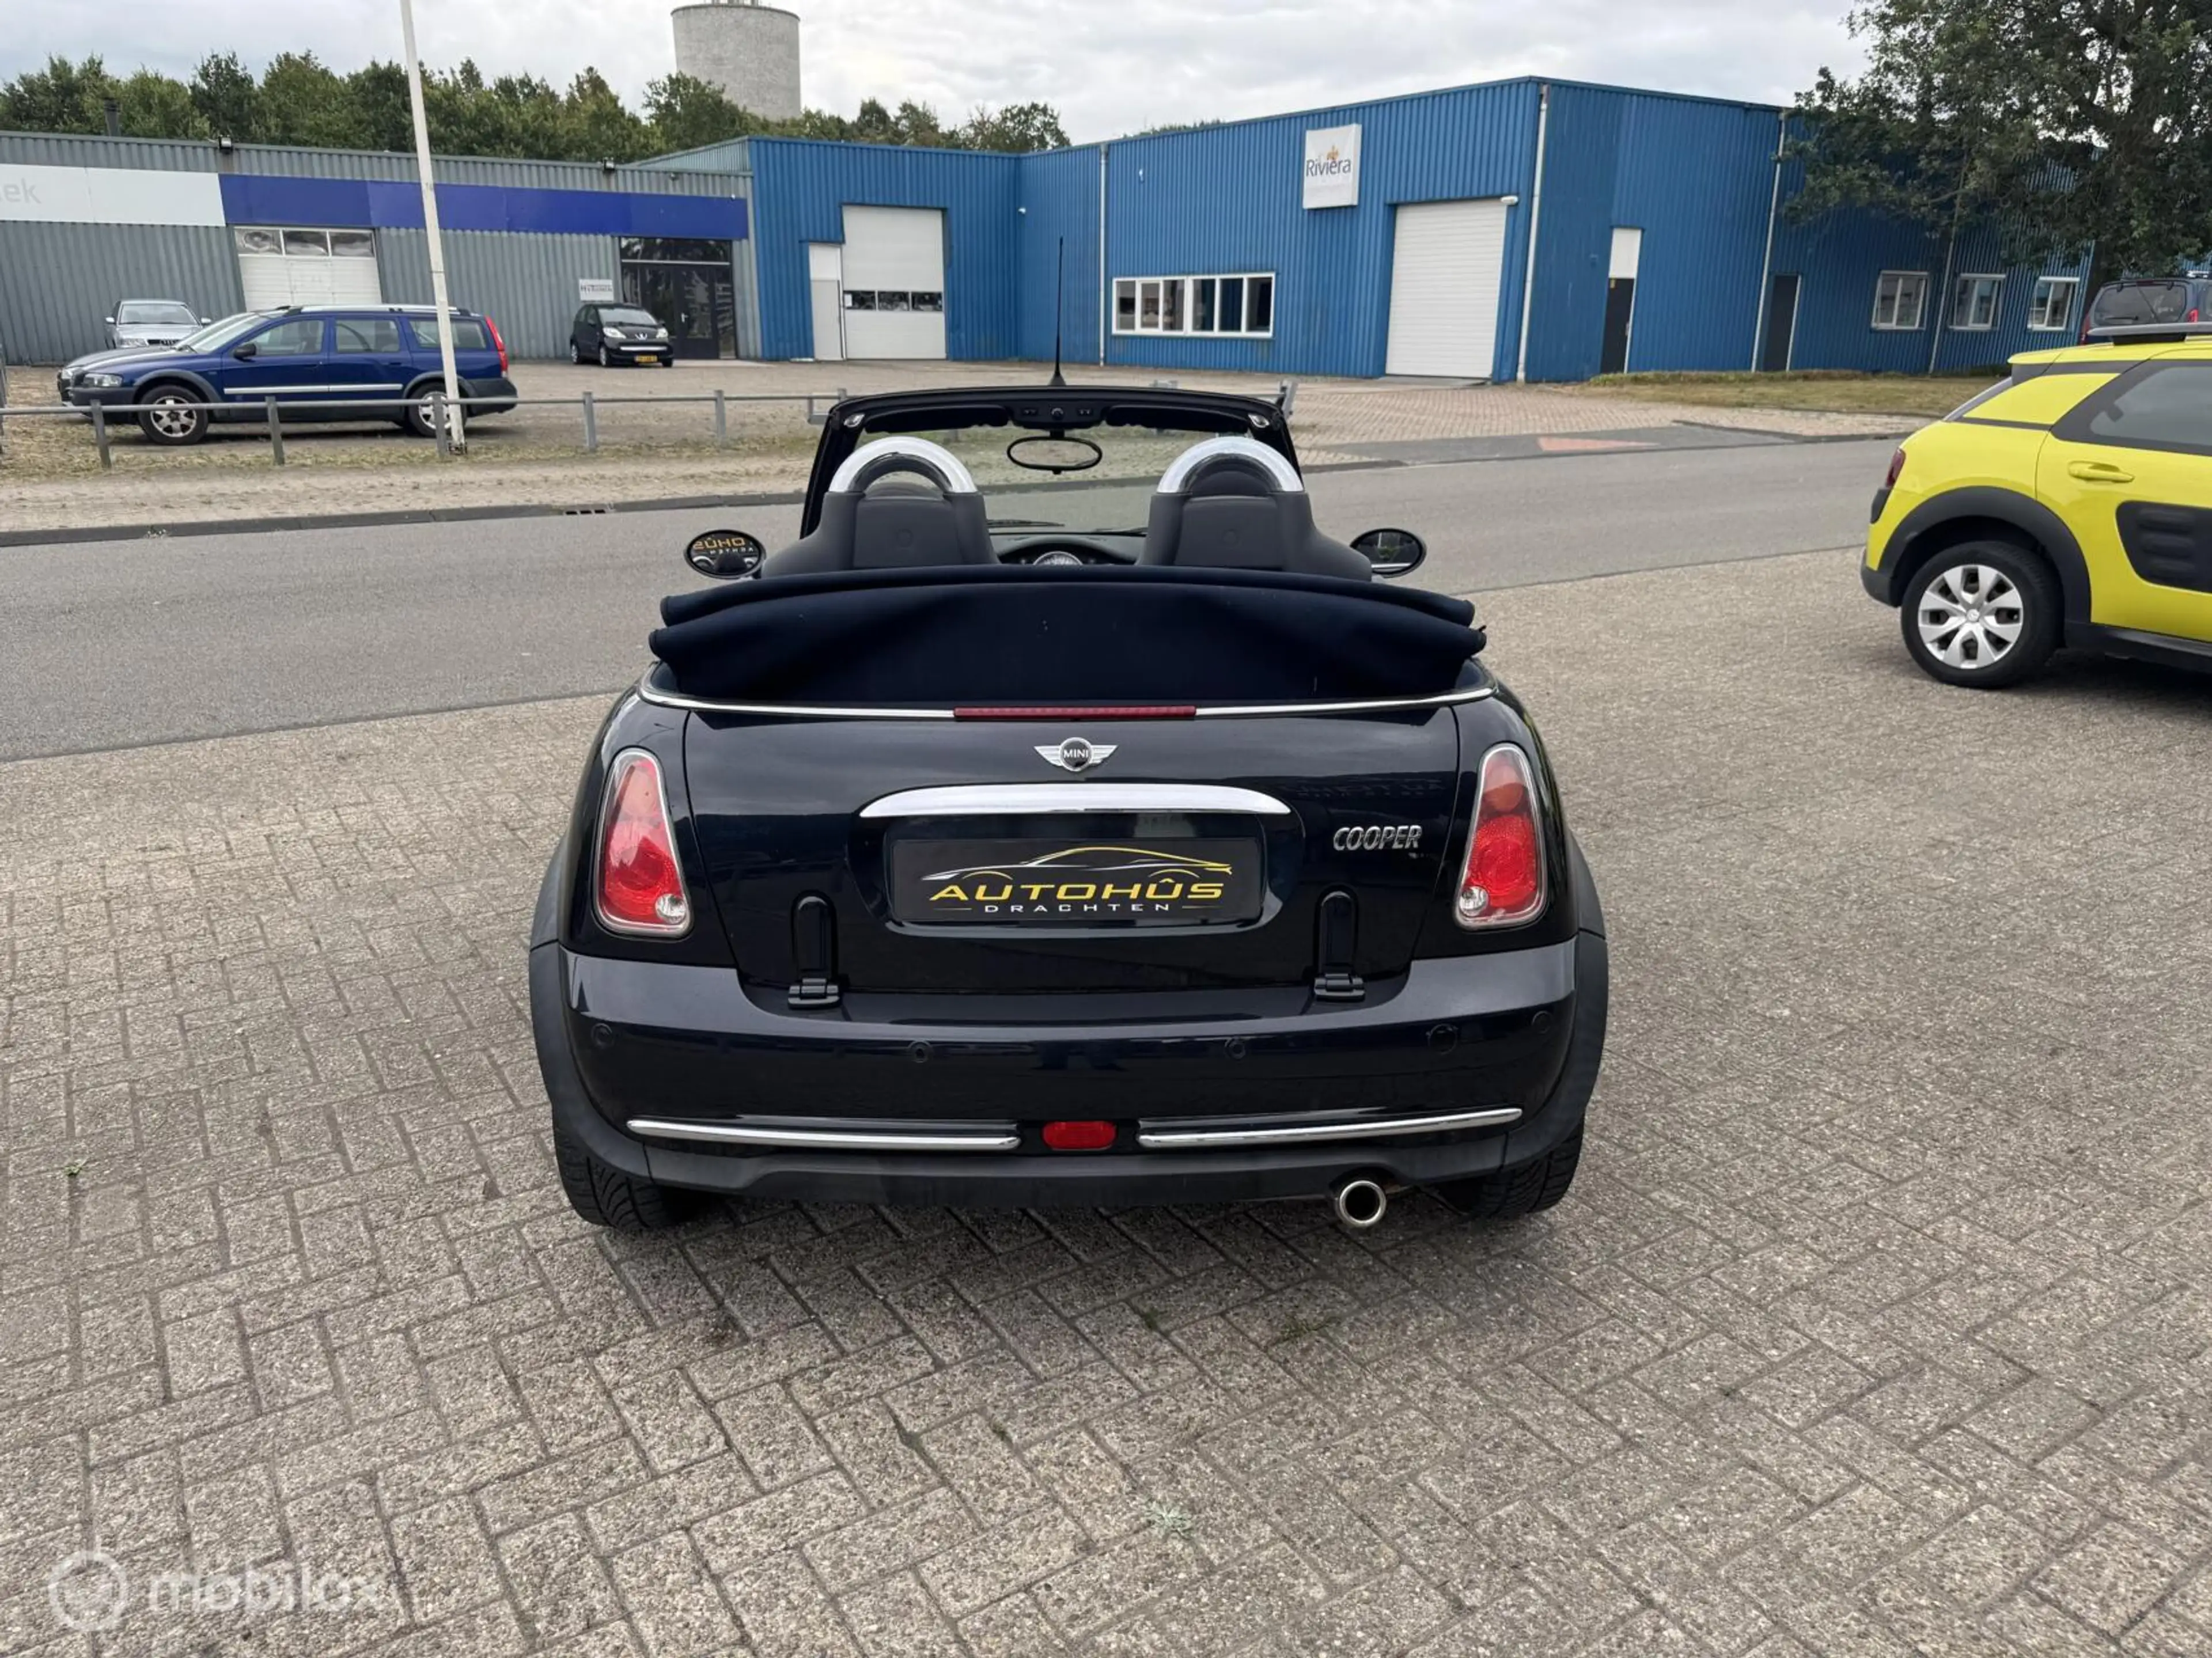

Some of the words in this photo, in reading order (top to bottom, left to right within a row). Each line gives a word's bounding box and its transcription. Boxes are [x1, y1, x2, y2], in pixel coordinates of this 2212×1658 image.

[1306, 157, 1351, 177] Riviera
[0, 177, 41, 204] ek
[1063, 749, 1089, 758] MINI
[1333, 825, 1422, 851] COOPER
[984, 904, 1170, 912] DRACHTEN
